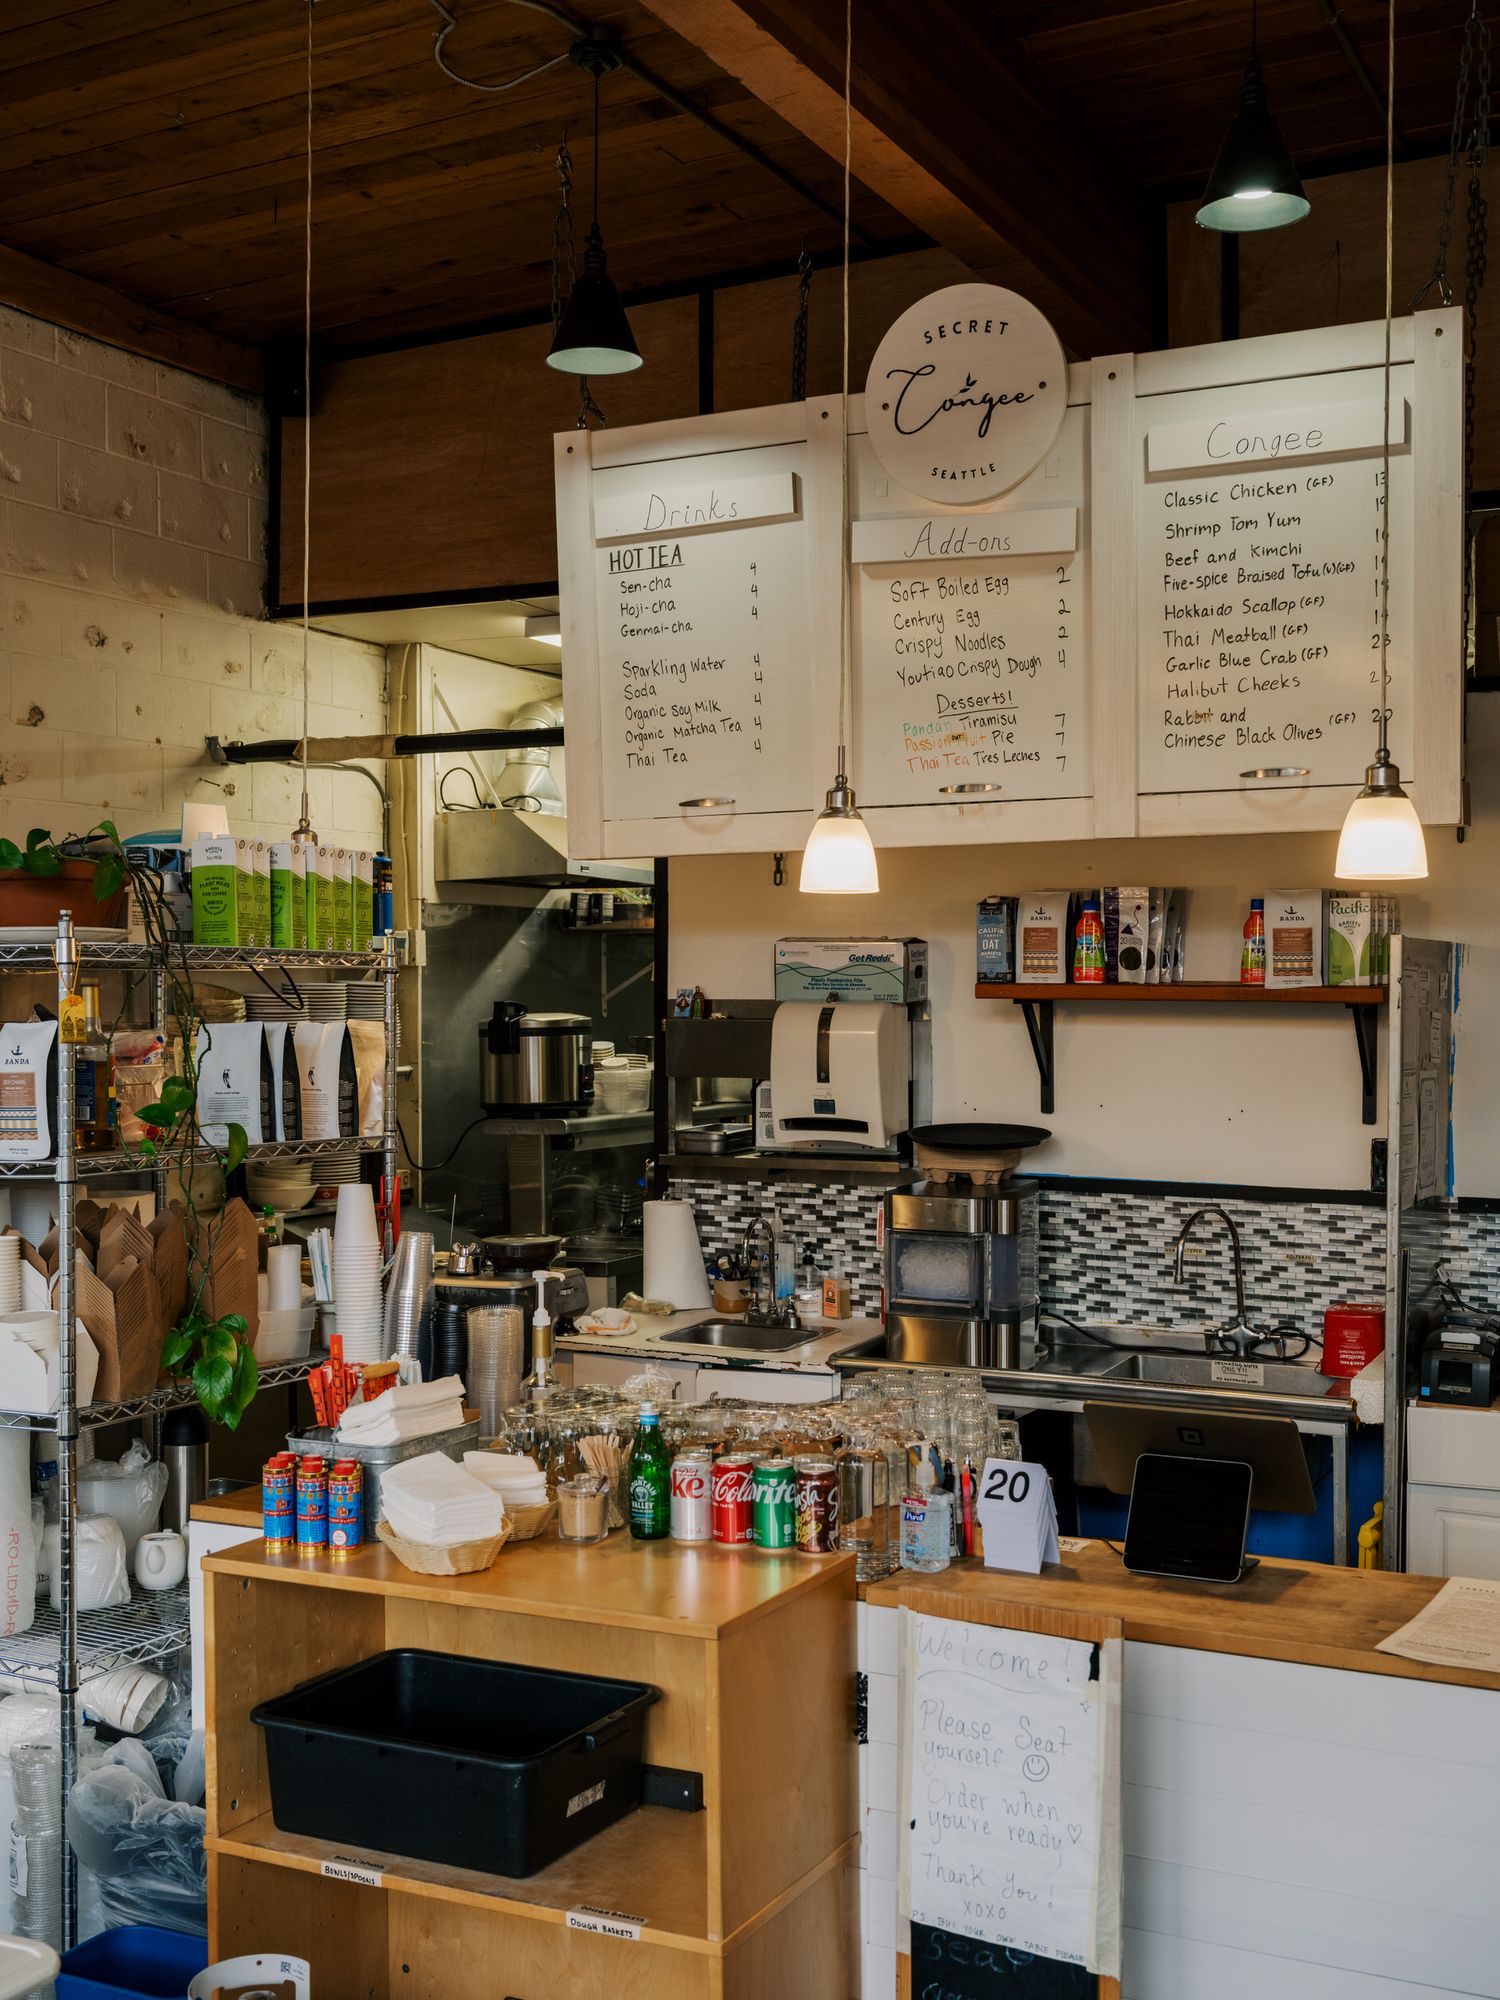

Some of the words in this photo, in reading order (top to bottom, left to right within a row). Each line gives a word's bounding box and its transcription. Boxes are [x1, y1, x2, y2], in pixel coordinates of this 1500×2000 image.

[923, 320, 1009, 344] SECRET
[886, 365, 1034, 438] Congee
[1207, 422, 1323, 459] Congee
[931, 463, 996, 480] SEATTLE
[1164, 491, 1220, 509] Classic
[1230, 482, 1297, 501] Chicken
[1306, 474, 1334, 492] (GF)
[643, 490, 737, 530] Drinks
[904, 521, 1011, 558] Add-ons
[1165, 523, 1221, 541] Shrimp
[1230, 515, 1258, 532] Tom
[1267, 512, 1301, 529] Yum
[609, 547, 644, 573] HOT
[648, 544, 682, 568] TEA
[1165, 550, 1199, 568] Beef
[1207, 548, 1237, 565] and
[1250, 542, 1302, 558] Kimchi
[620, 576, 672, 594] Sen-cha
[750, 562, 757, 576] 4
[937, 577, 979, 599] Boiled
[985, 577, 1009, 595] Egg
[1056, 567, 1071, 584] 2
[1237, 564, 1285, 584] Braised
[620, 599, 676, 618] Hoji-cha
[751, 584, 758, 598] 4
[1164, 603, 1233, 621] Hokkaido
[1242, 598, 1296, 615] Scallop
[1300, 595, 1325, 610] (GF)
[620, 621, 693, 638] Genmai-cha
[751, 606, 758, 620] 4
[894, 610, 945, 634] Century
[956, 609, 980, 627] Egg
[1058, 599, 1071, 615] 2
[895, 636, 944, 658] Crispy
[955, 632, 1006, 652] Noodles
[1058, 626, 1069, 639] 2
[1163, 630, 1200, 648] Thai
[1211, 626, 1276, 646] Meatball
[1282, 623, 1309, 639] (GF)
[622, 658, 687, 683] Sparkling
[753, 653, 760, 667] 4
[897, 664, 954, 688] Youtiao
[957, 658, 1001, 679] Crispy
[1008, 656, 1042, 679] Dough
[1058, 649, 1066, 669] 4
[1166, 656, 1211, 673] Garlic
[1219, 652, 1251, 669] Blue
[1260, 649, 1297, 666] Crab
[1301, 645, 1329, 662] (GF)
[624, 683, 657, 701] Soda
[754, 671, 763, 683] 4
[1167, 677, 1229, 700] Halibut
[1237, 674, 1301, 693] Cheeks
[625, 705, 667, 730] Organic
[695, 700, 722, 715] Milk
[754, 692, 762, 705] 4
[936, 690, 1014, 714] Desserts!
[1220, 707, 1246, 724] and
[1329, 712, 1356, 727] (GF)
[625, 729, 665, 751] Organic
[673, 723, 717, 739] Matcha
[720, 717, 743, 734] Tea
[754, 716, 762, 730] 4
[959, 713, 1017, 731] Tiramisu
[1054, 713, 1066, 728] 7
[1164, 732, 1226, 750] Chinese
[1236, 726, 1276, 746] Black
[1283, 723, 1323, 741] Olives
[992, 730, 1015, 746] Pie
[1055, 732, 1065, 746] 7
[627, 752, 655, 769] Thai
[663, 747, 688, 764] Tea
[754, 739, 762, 753] 4
[906, 756, 940, 774] Thai
[942, 752, 970, 767] Tea
[973, 751, 999, 766] Tres
[1003, 750, 1041, 763] Leches
[1056, 755, 1066, 772] 7
[978, 927, 1005, 935] CALIFIA
[982, 939, 1000, 950] OAT
[984, 1469, 1030, 1503] 20
[921, 1699, 993, 1742] Please
[1015, 1715, 1073, 1756] Seat
[924, 1740, 1004, 1776] yourself
[928, 1777, 988, 1811] Order
[1002, 1790, 1060, 1823] when
[929, 1809, 992, 1845] you're
[1008, 1825, 1063, 1869] ready
[922, 1852, 985, 1887] Thank
[570, 1917, 598, 1931] DOUGH
[996, 1934, 1015, 1944] OWN
[1024, 1941, 1049, 1953] TABLE
